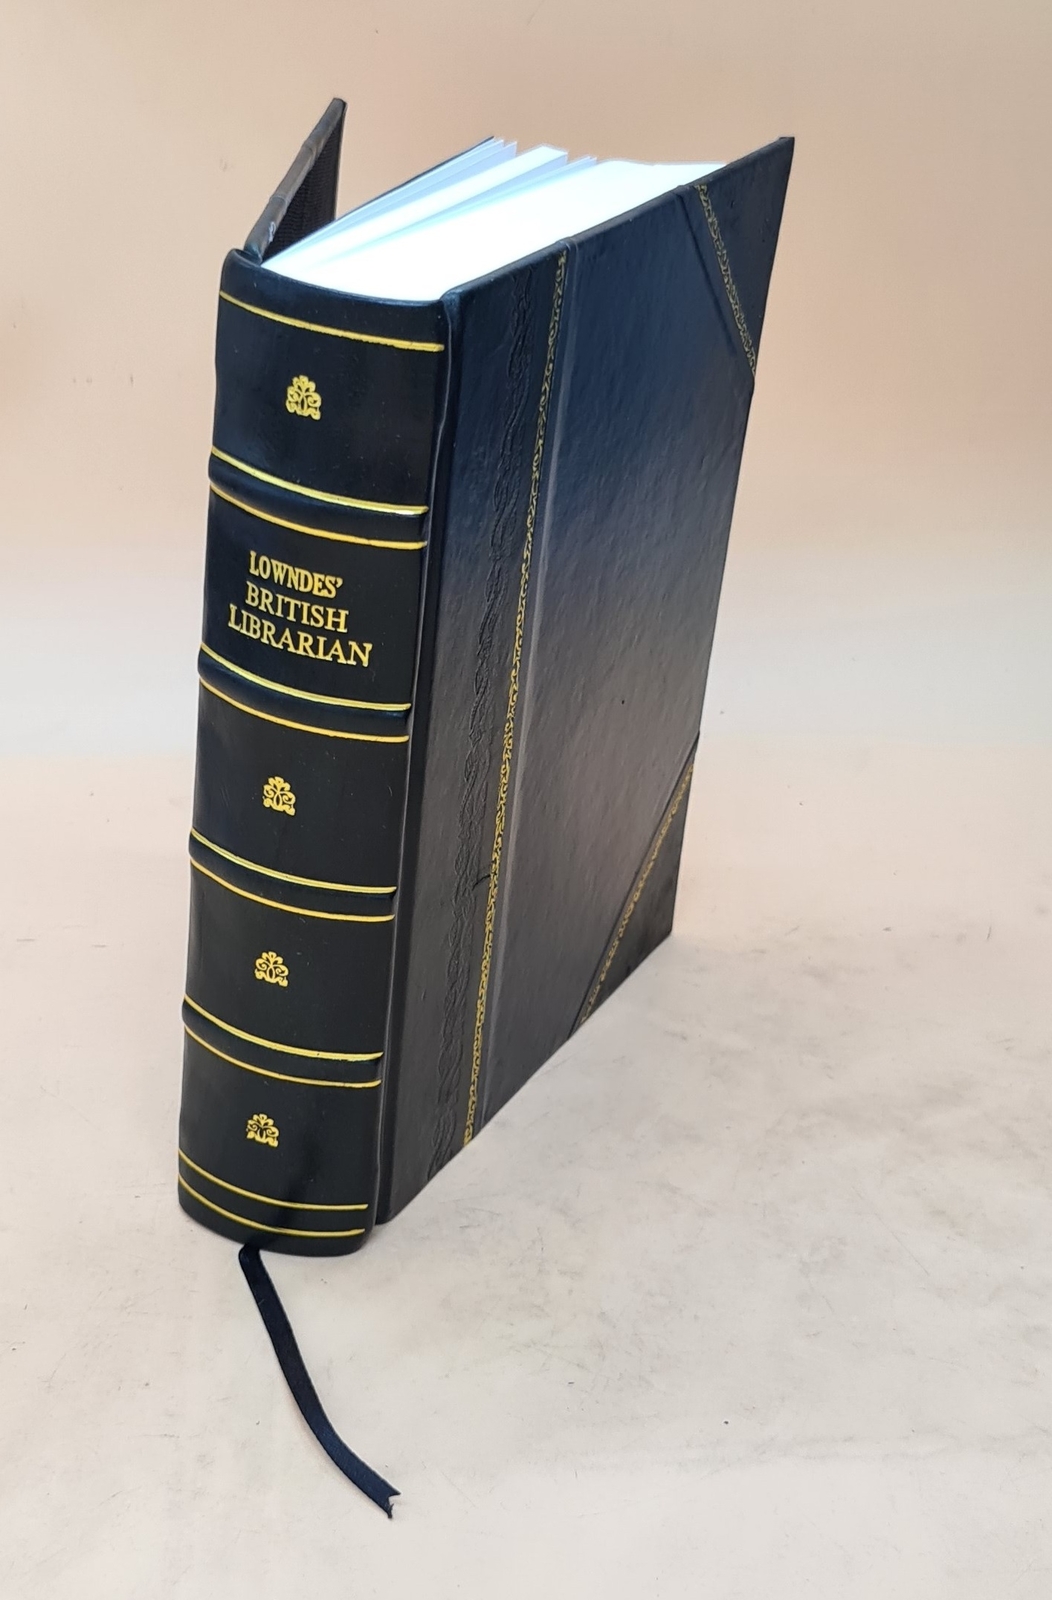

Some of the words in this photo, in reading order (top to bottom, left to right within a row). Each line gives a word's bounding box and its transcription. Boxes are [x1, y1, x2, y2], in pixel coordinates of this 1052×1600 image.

[250, 550, 343, 598] LOWNDES'
[245, 581, 348, 633] BRITISH
[228, 603, 373, 667] LIBRARIAN
